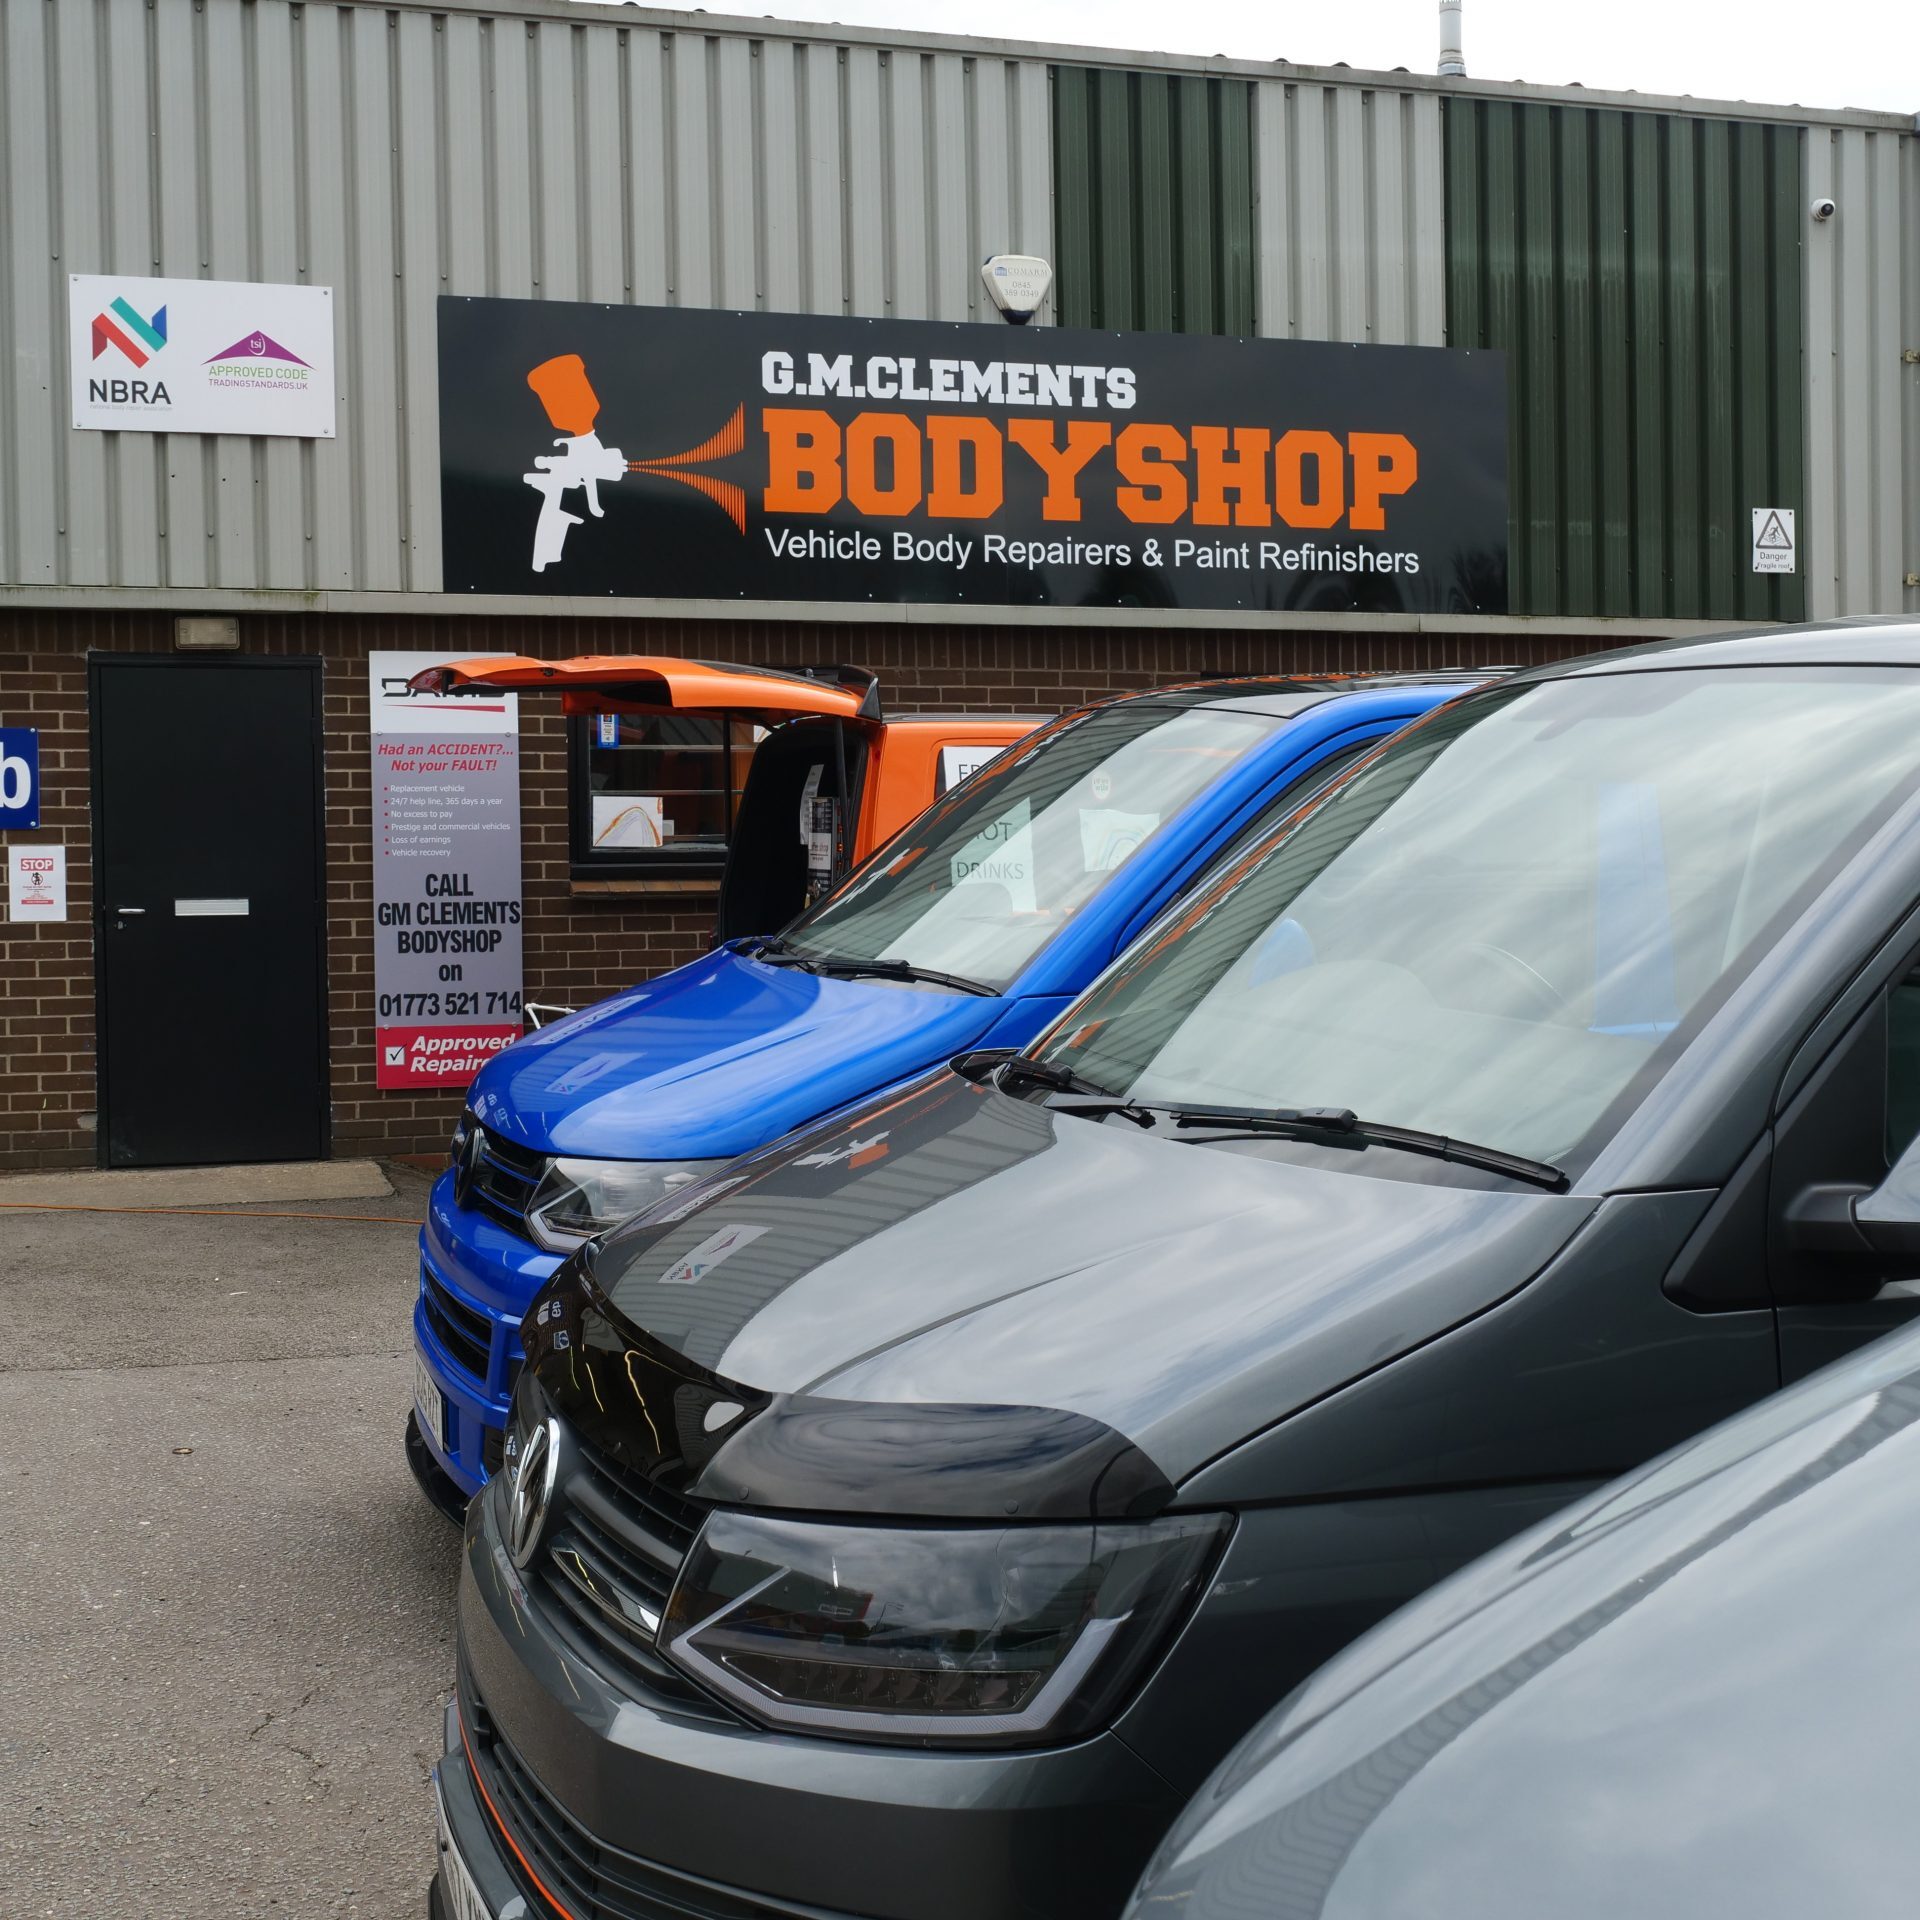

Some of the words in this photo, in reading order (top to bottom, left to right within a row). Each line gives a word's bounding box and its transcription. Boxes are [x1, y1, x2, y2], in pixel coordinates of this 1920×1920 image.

[250, 338, 262, 349] tsi
[209, 366, 273, 378] APPROVED
[276, 368, 308, 380] CODE
[762, 351, 1136, 409] G.M.CLEMENTS
[90, 379, 172, 405] NBRA
[209, 379, 308, 390] TRADINGSTANDARDS.UK
[762, 408, 1418, 531] BODYSHOP
[765, 528, 881, 561] Vehicle
[893, 532, 972, 570] Body
[984, 536, 1131, 570] Repairers
[1142, 540, 1164, 567] &
[1176, 540, 1249, 569] Paint
[1260, 542, 1420, 574] Refinishers
[1760, 552, 1787, 561] Danger
[378, 744, 405, 755] Had
[408, 746, 423, 755] an
[391, 760, 415, 771] Not
[418, 761, 448, 774] your
[451, 760, 497, 771] FAULT!
[390, 785, 438, 793] Replacement
[391, 798, 408, 806] 24/7
[410, 798, 426, 806] help
[461, 798, 478, 806] days
[391, 823, 421, 832] Prestige
[977, 822, 1013, 841] OT
[419, 837, 451, 845] earnings
[21, 859, 53, 870] STOP
[957, 862, 1024, 879] DRINKS
[425, 873, 474, 897] CALL
[378, 902, 411, 926] GM
[416, 901, 521, 925] CLEMENTS
[397, 929, 502, 954] BODYSHOP
[438, 963, 463, 981] on
[379, 992, 440, 1017] 01773
[445, 992, 479, 1016] 521
[486, 991, 521, 1014] 714
[410, 1033, 516, 1055] Approved
[410, 1054, 491, 1076] Repair
